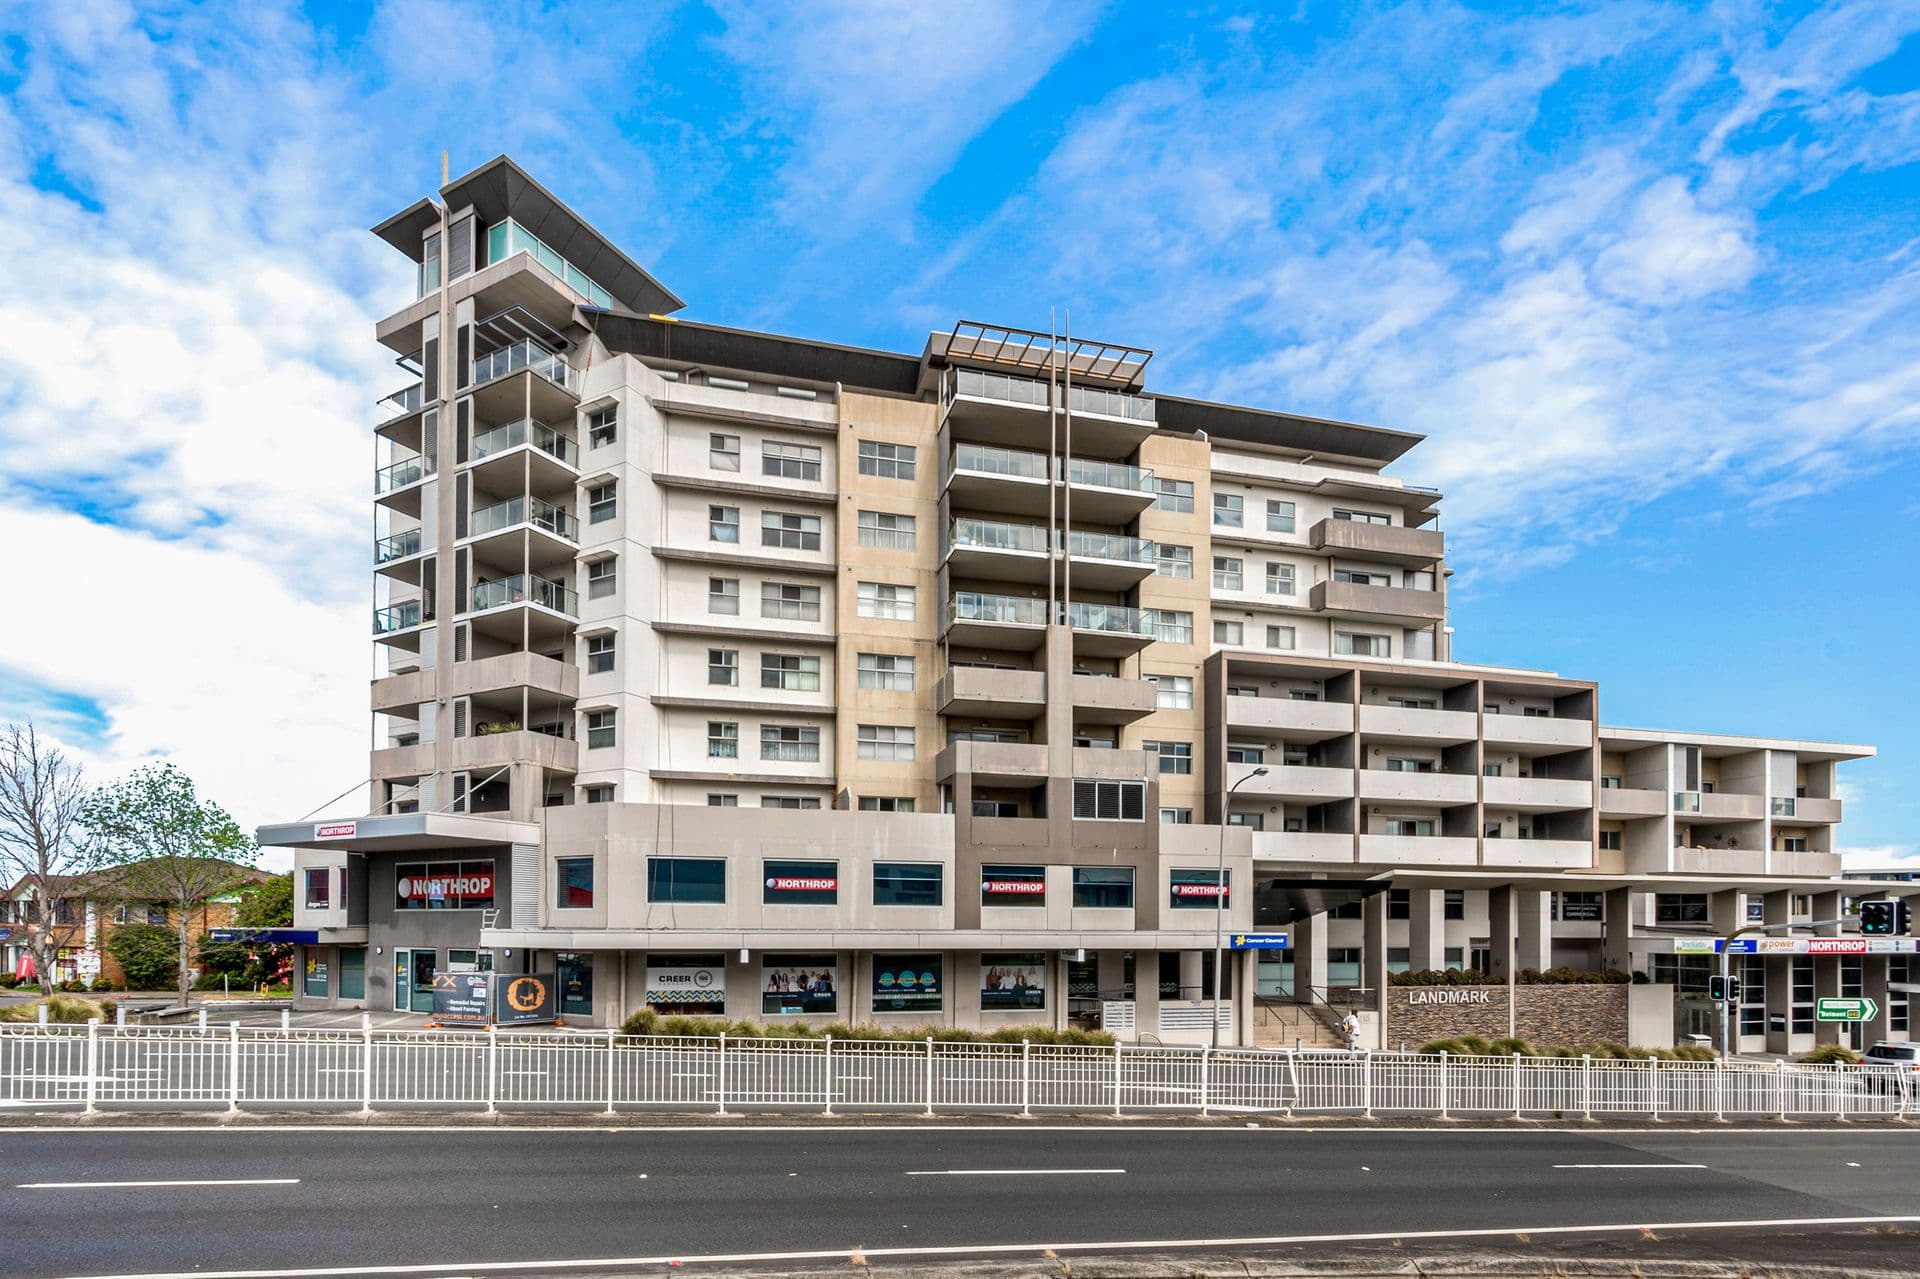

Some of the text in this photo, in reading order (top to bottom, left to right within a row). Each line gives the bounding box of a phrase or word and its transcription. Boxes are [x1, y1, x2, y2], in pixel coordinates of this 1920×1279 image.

[321, 825, 354, 836] NORTHROP
[413, 877, 491, 895] NORTHROP
[778, 879, 835, 889] NORTHROP
[992, 883, 1043, 891] NORTHROP
[1768, 940, 1795, 950] power
[1810, 941, 1865, 951] NORTHROP
[658, 975, 692, 983] CREER
[1409, 990, 1490, 1004] LANDMARK
